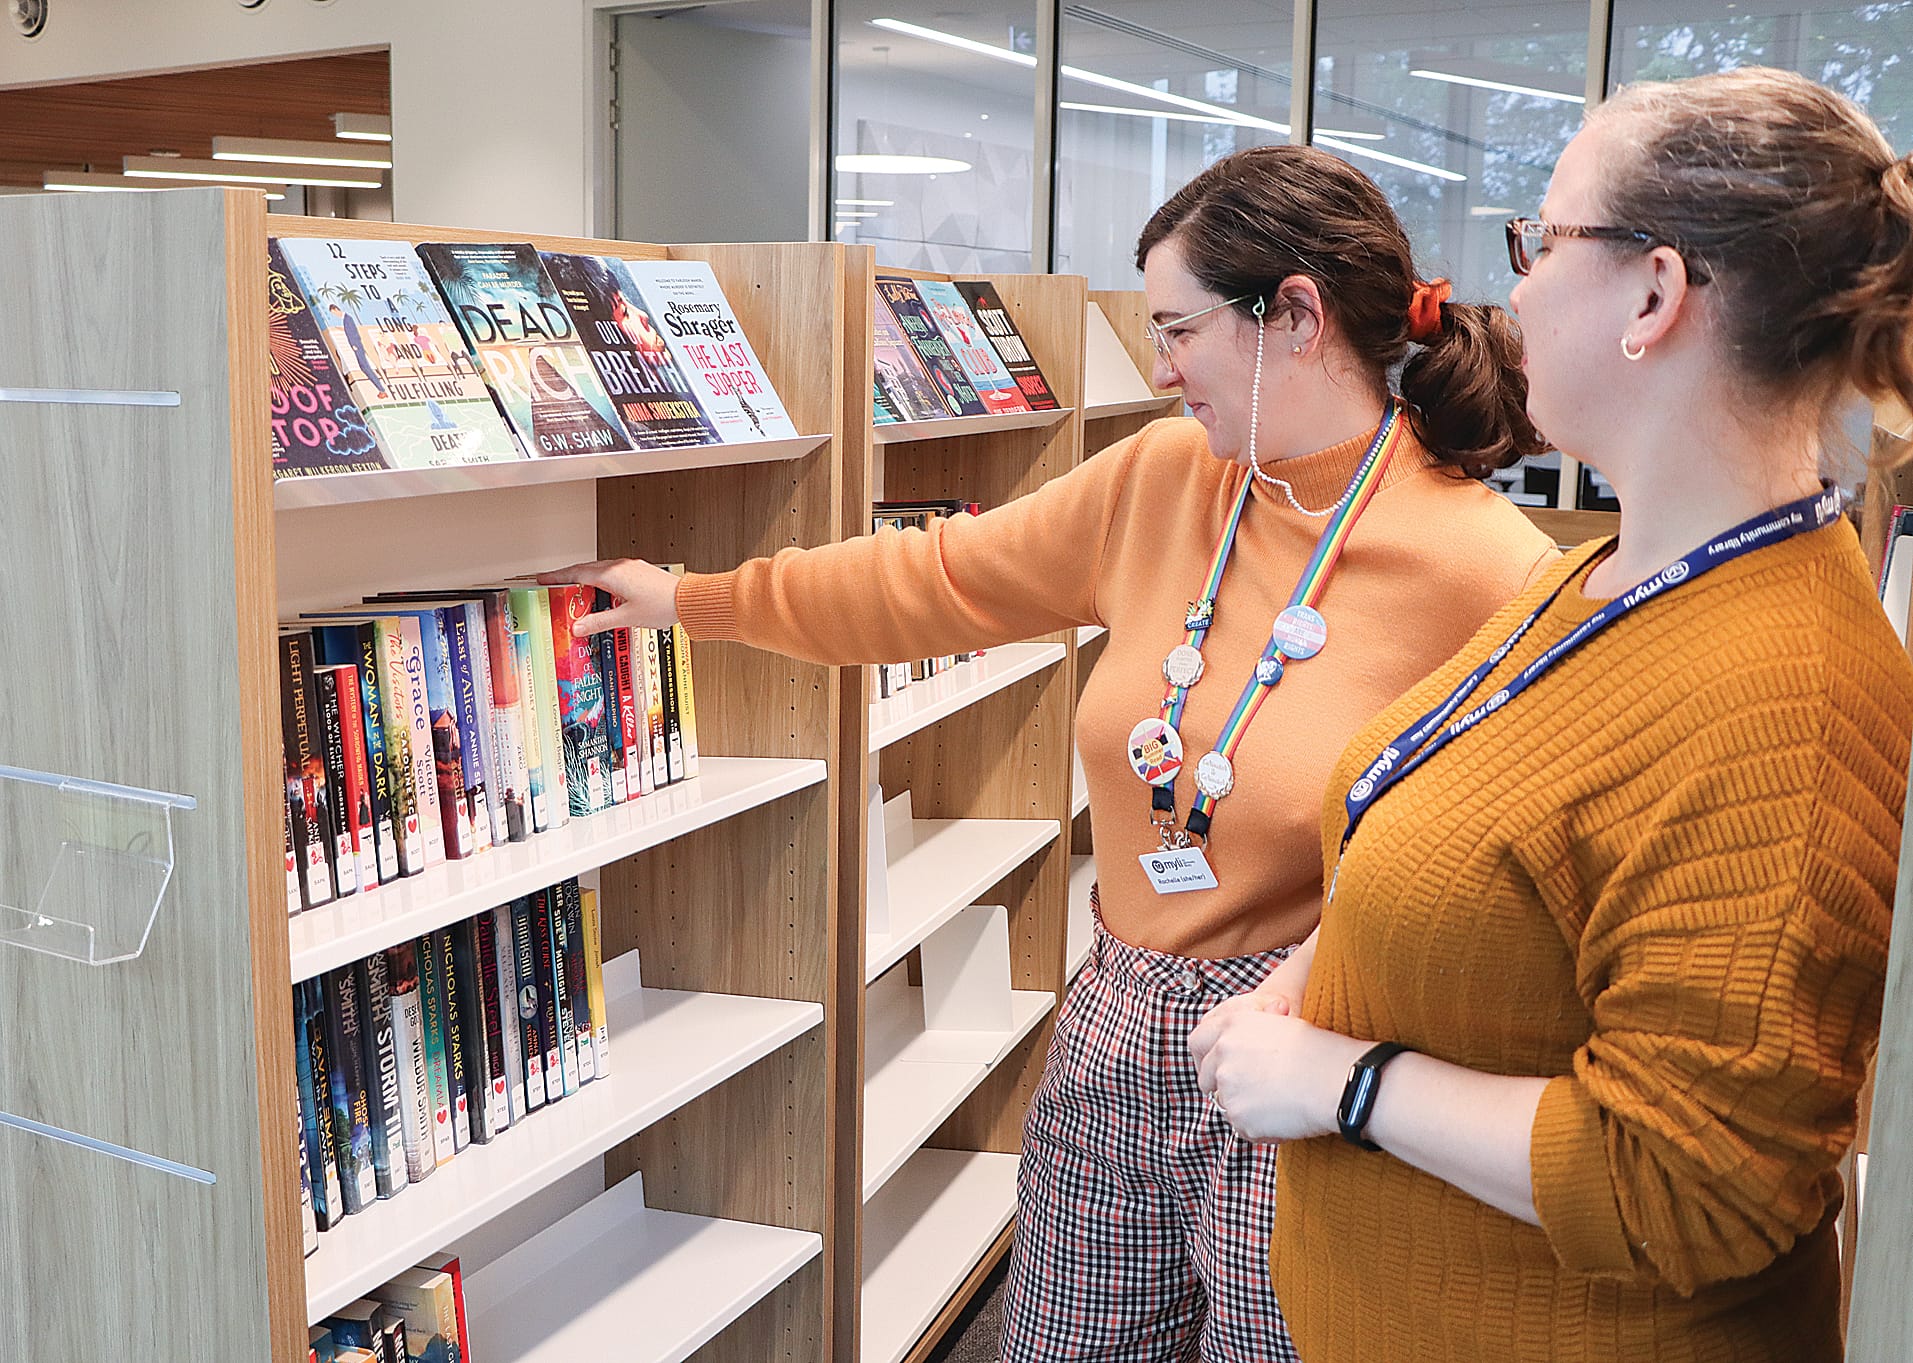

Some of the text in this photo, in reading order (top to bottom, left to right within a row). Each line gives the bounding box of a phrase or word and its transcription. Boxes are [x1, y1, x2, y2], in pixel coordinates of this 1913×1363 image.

[325, 243, 347, 260] 12
[345, 263, 387, 280] STEPS
[361, 284, 381, 300] TO
[388, 298, 399, 313] A
[458, 302, 572, 343] DEAD
[667, 301, 721, 318] Rosemary
[977, 309, 1014, 335] SCOTT
[376, 317, 413, 333] LONG
[595, 321, 626, 345] OUT
[664, 312, 736, 341] Shrager
[394, 343, 422, 360] AND
[683, 342, 751, 369] THE LAST
[486, 344, 604, 400] RICH
[591, 350, 688, 395] BREATH
[705, 370, 763, 396] SUPPER
[387, 380, 463, 399] FULFILLING
[272, 417, 339, 447] TOP
[540, 434, 575, 452] G.W.
[578, 429, 613, 447] SHAW
[1740, 517, 1791, 543] community
[1708, 537, 1742, 556] library
[1623, 578, 1663, 608] myli
[616, 629, 627, 651] WHO
[289, 640, 303, 684] LIGHT
[387, 633, 404, 720] The Visitors
[456, 620, 475, 725] East of Alice
[620, 654, 631, 692] CAUGHT
[406, 646, 425, 730] Grace
[574, 672, 602, 689] FALLEN
[576, 687, 604, 704] NIGHT
[622, 695, 632, 704] A
[294, 688, 312, 771] PERPETUAL
[364, 650, 380, 728] WOMAN
[373, 752, 388, 800] DARK
[1450, 705, 1486, 735] myli
[328, 734, 334, 744] OF
[330, 692, 345, 779] THE WITCHER
[469, 731, 480, 769] ANNIE
[1143, 740, 1159, 754] BIG
[400, 730, 413, 794] CAROLINE
[424, 745, 435, 805] Victoria
[1367, 746, 1400, 781] myli
[417, 760, 426, 796] Scott
[1164, 857, 1184, 870] myli
[555, 885, 564, 908] HER
[554, 910, 563, 936] SIDE
[480, 911, 497, 985] Danielle
[555, 949, 567, 1000] MIDNIGHT
[367, 957, 385, 1023] SMITH
[339, 980, 355, 1035] SMITH
[427, 996, 439, 1044] SPARKS
[443, 935, 458, 1020] NICHOLAS
[451, 1024, 464, 1080] SPARKS
[486, 987, 502, 1037] Steel
[377, 1026, 399, 1111] STORM
[412, 1038, 428, 1140] WILBUR SMITH
[353, 1101, 362, 1125] FIRE
[359, 1090, 369, 1127] GHOST
